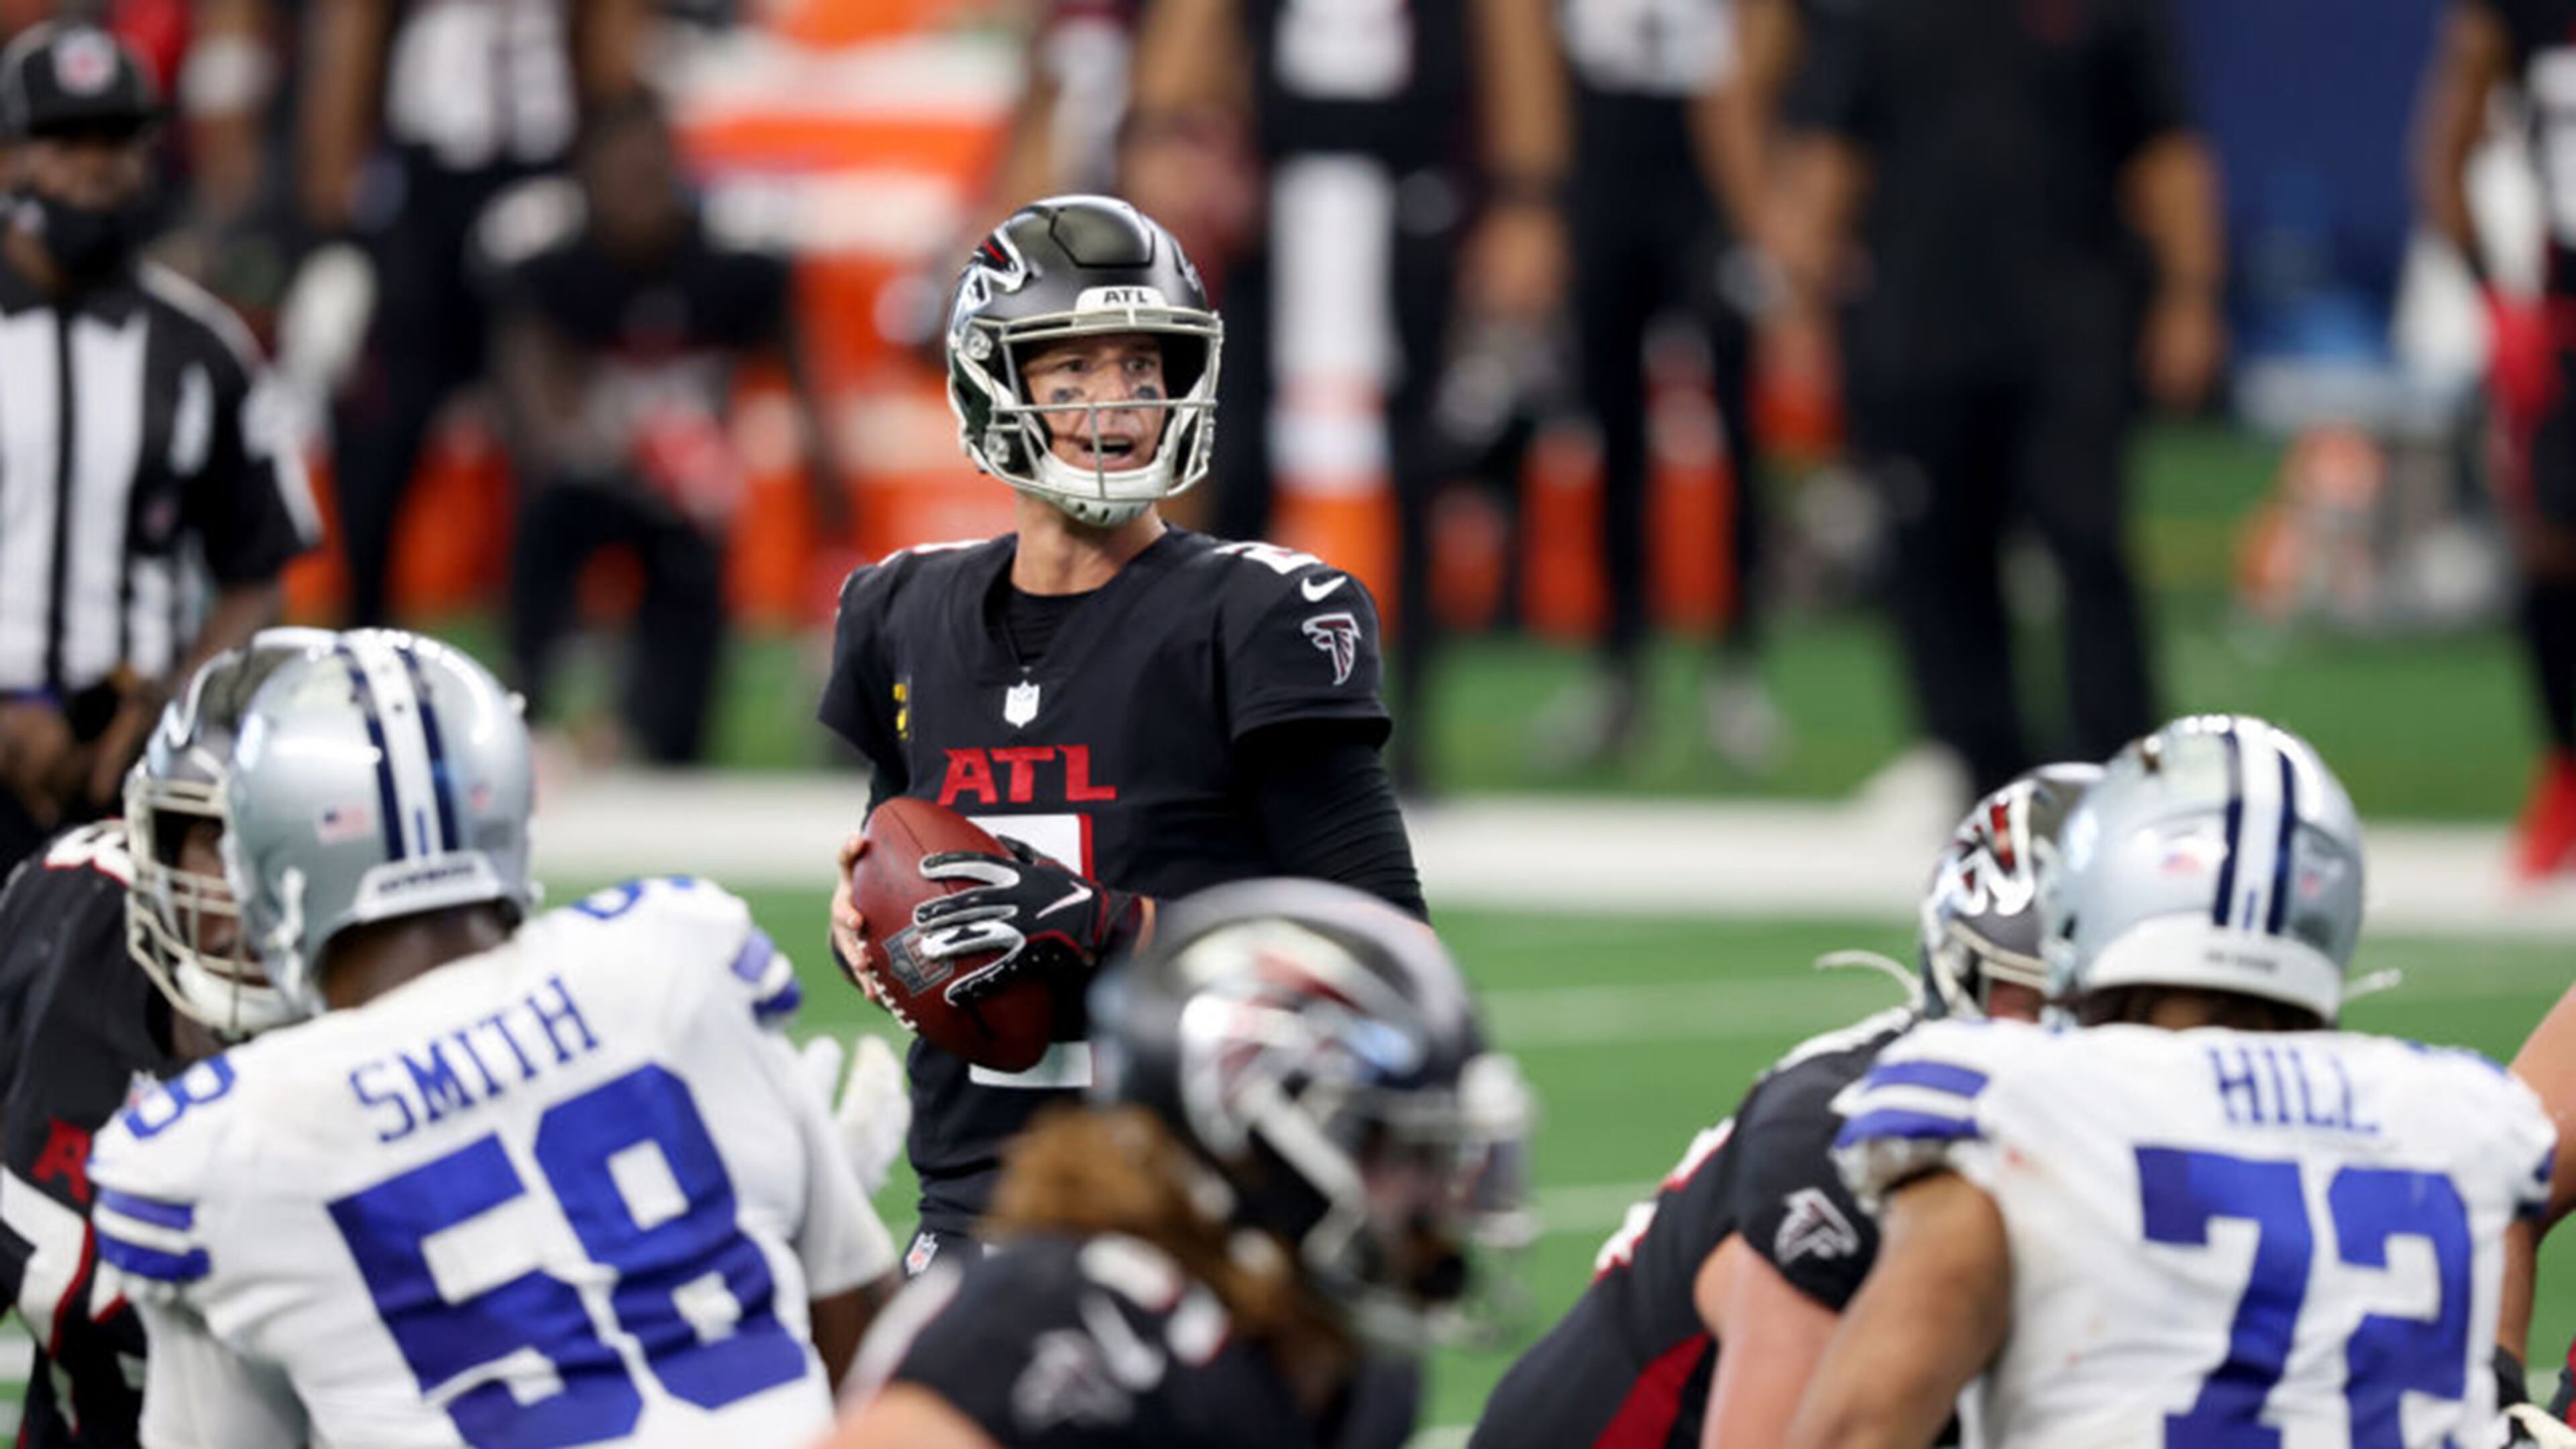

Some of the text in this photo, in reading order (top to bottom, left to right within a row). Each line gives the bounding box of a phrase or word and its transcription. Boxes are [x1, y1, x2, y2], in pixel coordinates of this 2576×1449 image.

[1104, 289, 1148, 304] ATL
[935, 744, 1118, 806] ATL
[349, 977, 598, 1143] SMITH
[2207, 1049, 2379, 1134] HILL
[326, 1060, 809, 1449] 58
[2134, 1145, 2475, 1449] 72
